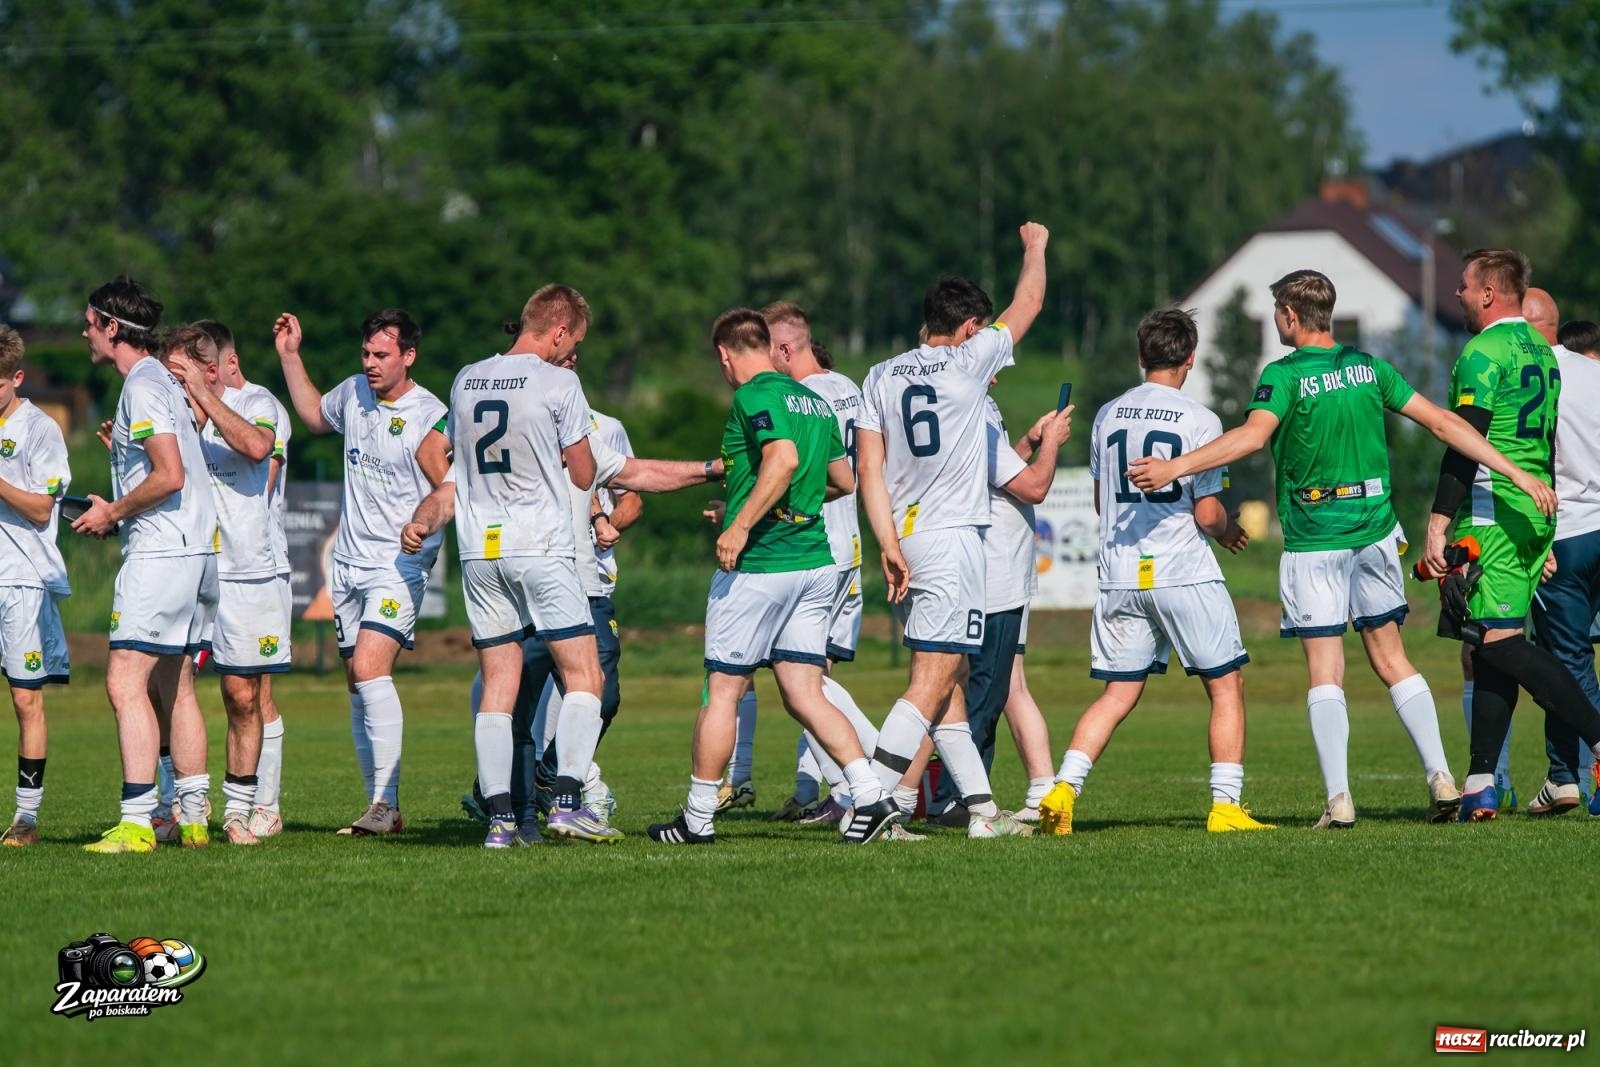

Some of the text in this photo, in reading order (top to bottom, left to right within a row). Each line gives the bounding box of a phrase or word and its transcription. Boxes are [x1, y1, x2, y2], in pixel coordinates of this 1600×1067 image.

[891, 364, 918, 377] BUK
[463, 376, 528, 391] BUK RUDY
[1299, 376, 1320, 399] KS
[901, 384, 941, 458] 6
[1115, 407, 1184, 423] BUK RUDY
[473, 399, 512, 475] 2
[966, 608, 983, 640] 6
